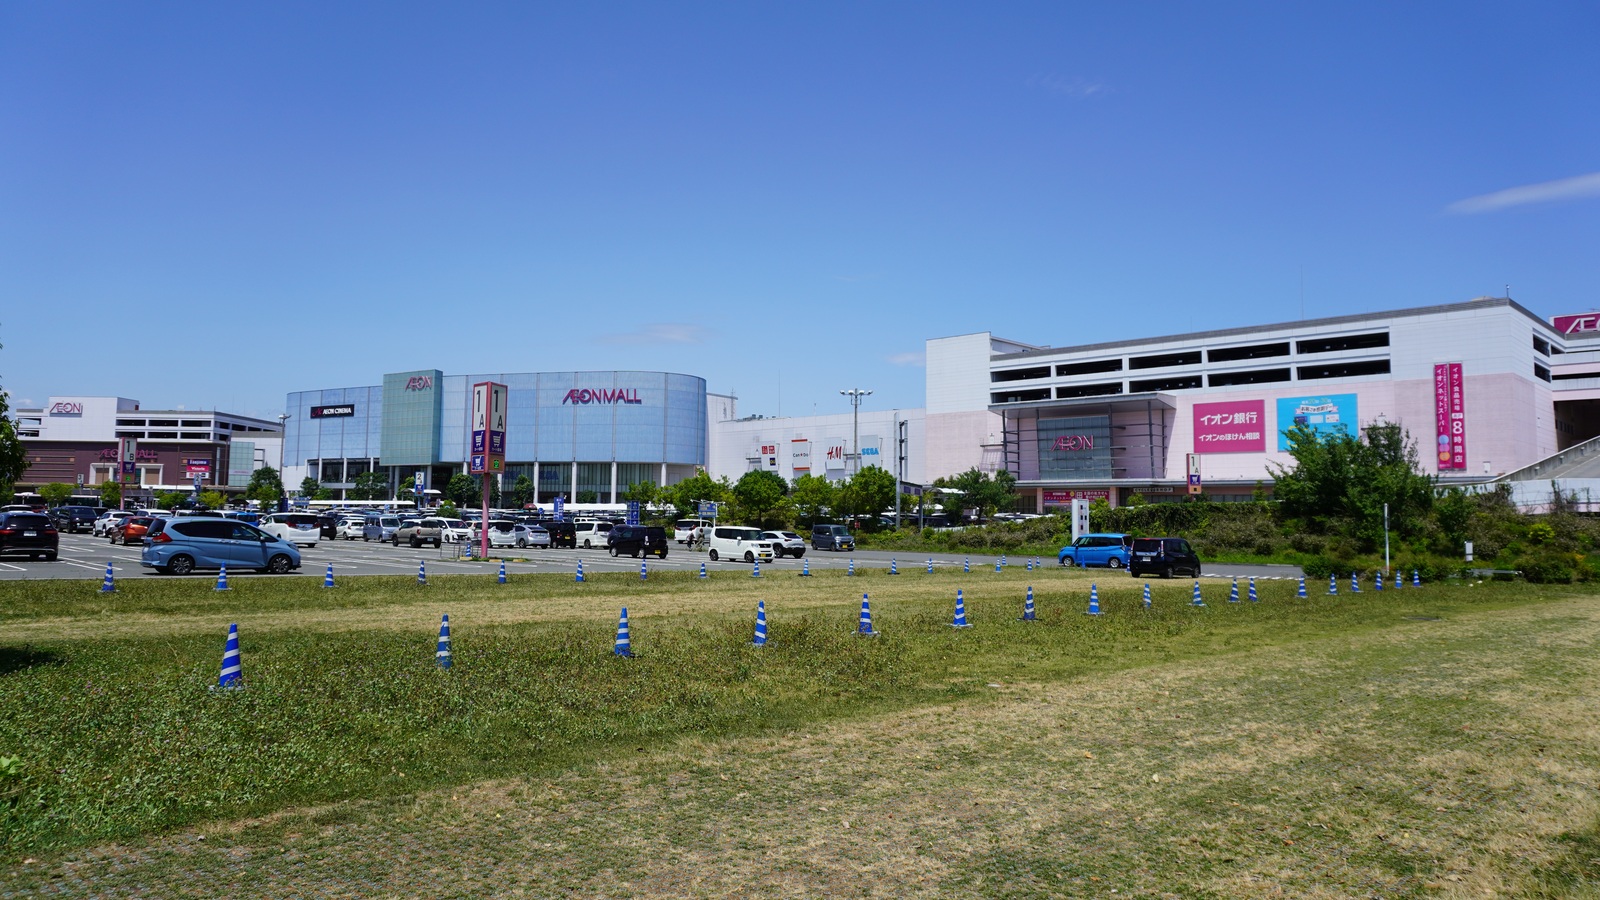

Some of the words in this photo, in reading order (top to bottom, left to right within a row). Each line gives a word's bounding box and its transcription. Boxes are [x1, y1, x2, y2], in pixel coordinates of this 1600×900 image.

[1452, 367, 1461, 411] イオン食品売場
[476, 390, 481, 412] 1
[493, 389, 499, 413] 1
[1436, 368, 1445, 433] イオンネットスーパー
[478, 413, 485, 428] A
[496, 414, 504, 430] A
[1200, 411, 1258, 426] イオン銀行
[1198, 432, 1261, 442] イオンのほけん相談
[126, 440, 130, 453] 1
[861, 447, 879, 455] SEGA
[129, 453, 135, 461] B
[1191, 456, 1195, 467] 1
